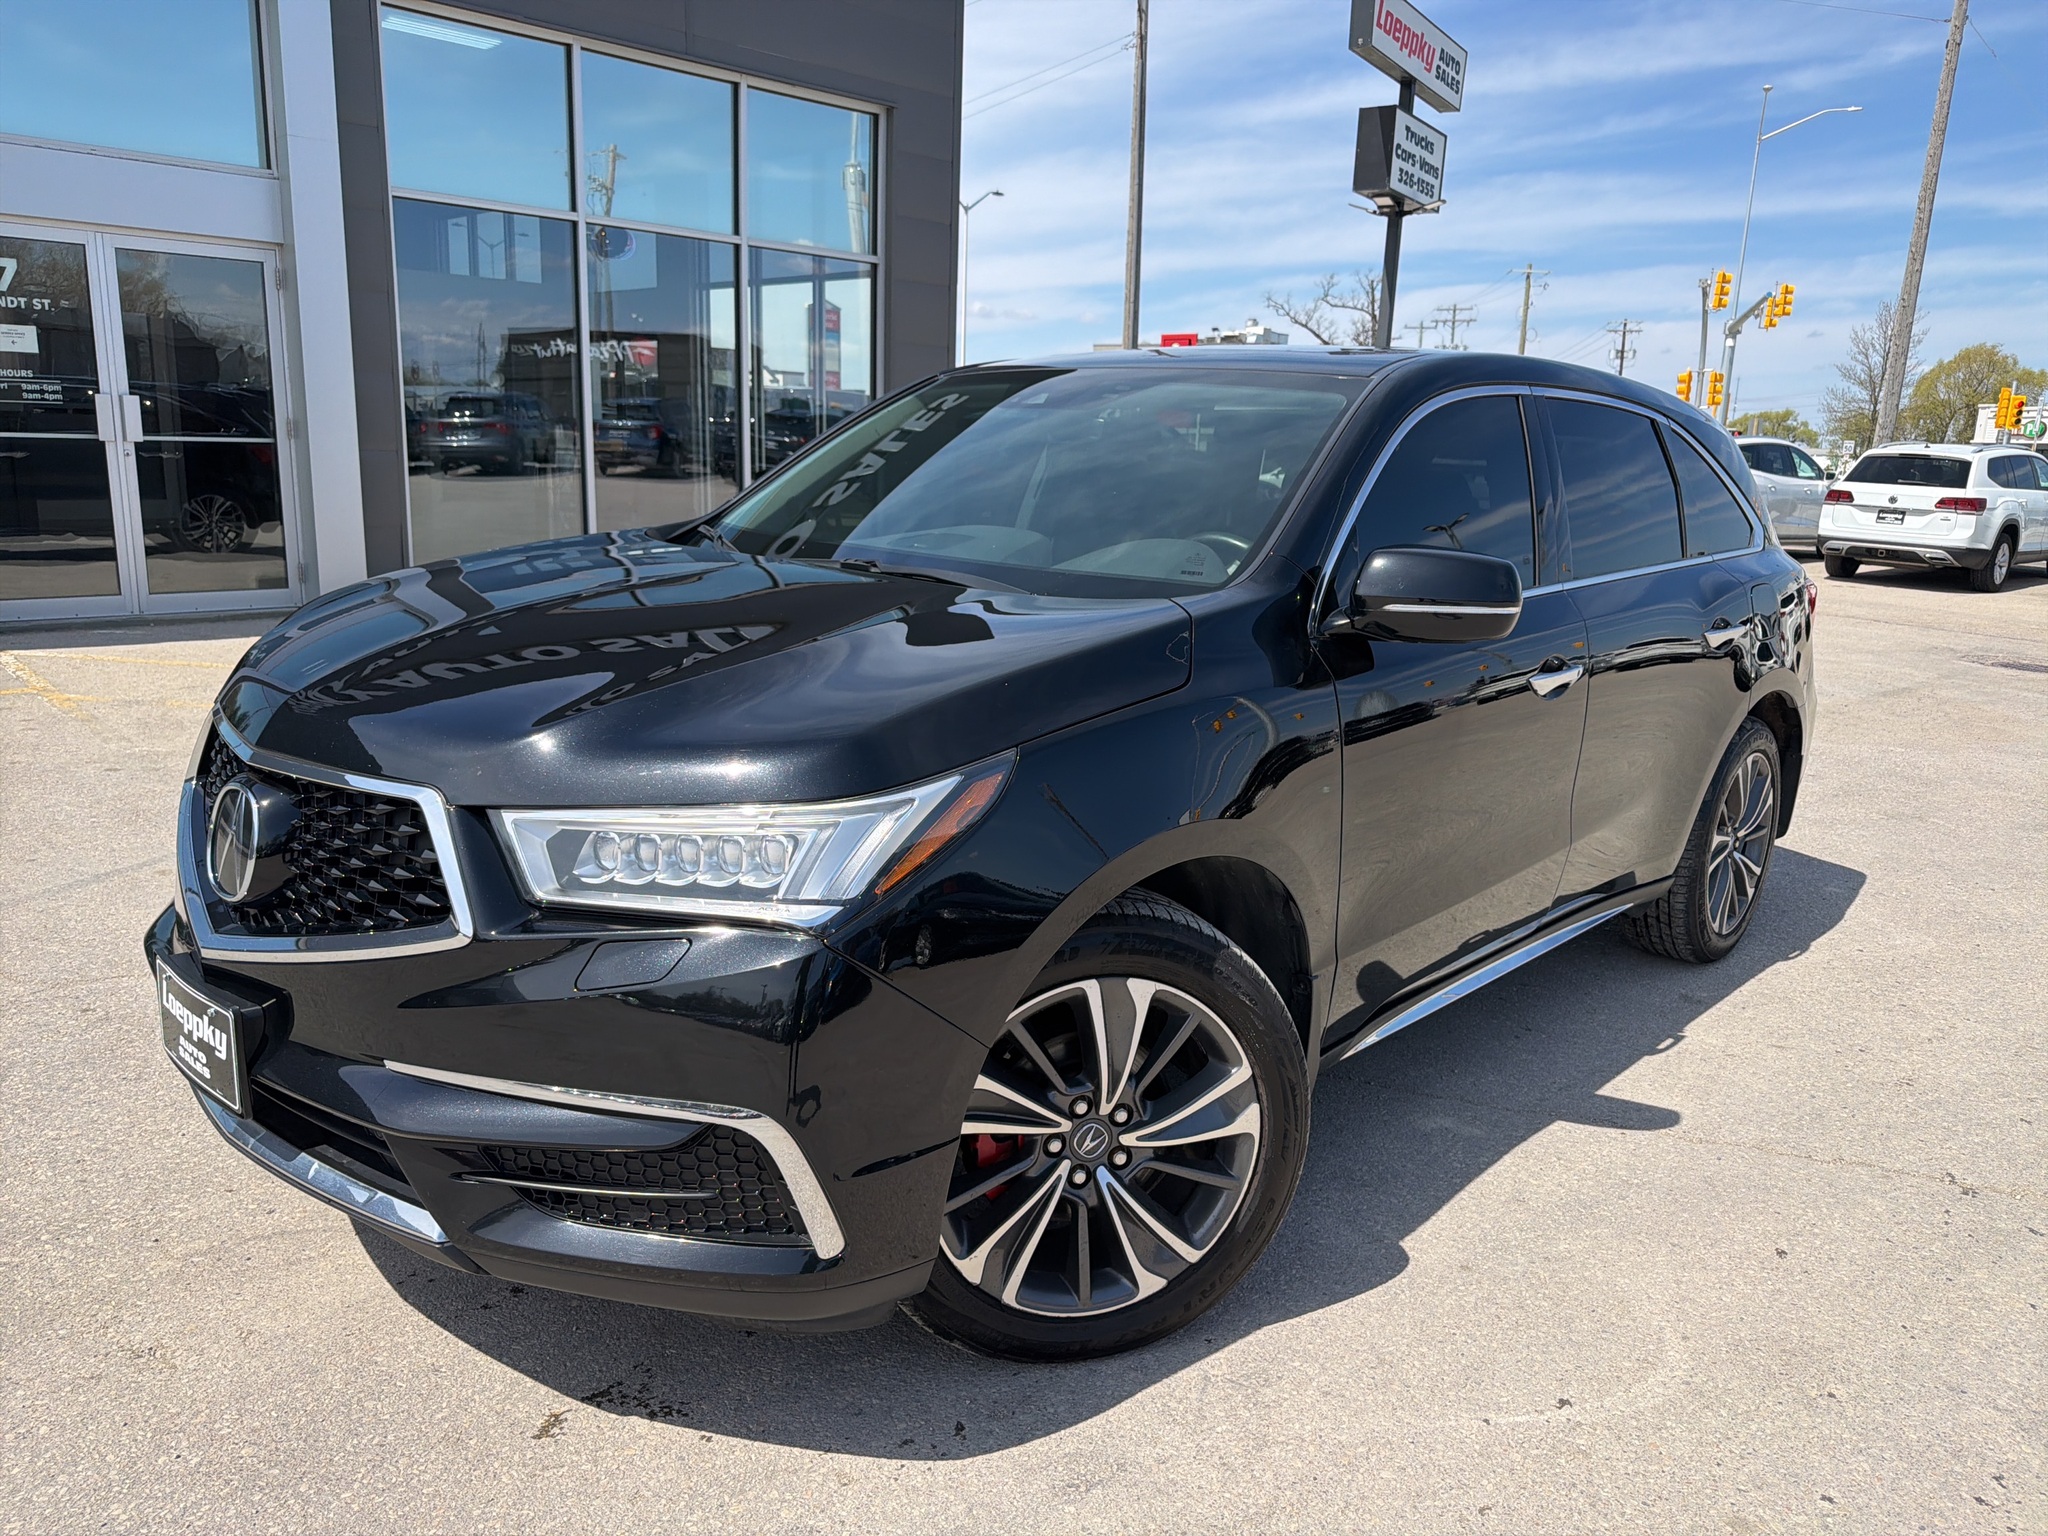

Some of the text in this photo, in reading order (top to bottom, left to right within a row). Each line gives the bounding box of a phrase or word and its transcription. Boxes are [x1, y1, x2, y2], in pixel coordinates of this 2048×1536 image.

[1376, 0, 1436, 74] Loeppky
[1439, 47, 1461, 76] AUTO
[1435, 64, 1461, 95] SALES
[1405, 124, 1435, 156] Trucks
[1397, 166, 1435, 200] 326-1555
[32, 297, 55, 311] ST.
[0, 368, 34, 378] HOURS
[21, 383, 62, 393] 9am-6pm
[22, 391, 63, 401] 9am-4pm
[1844, 445, 1853, 453] 50
[162, 974, 228, 1060] Loeppky
[178, 1046, 212, 1080] SALES
[179, 1035, 208, 1065] AUTO
